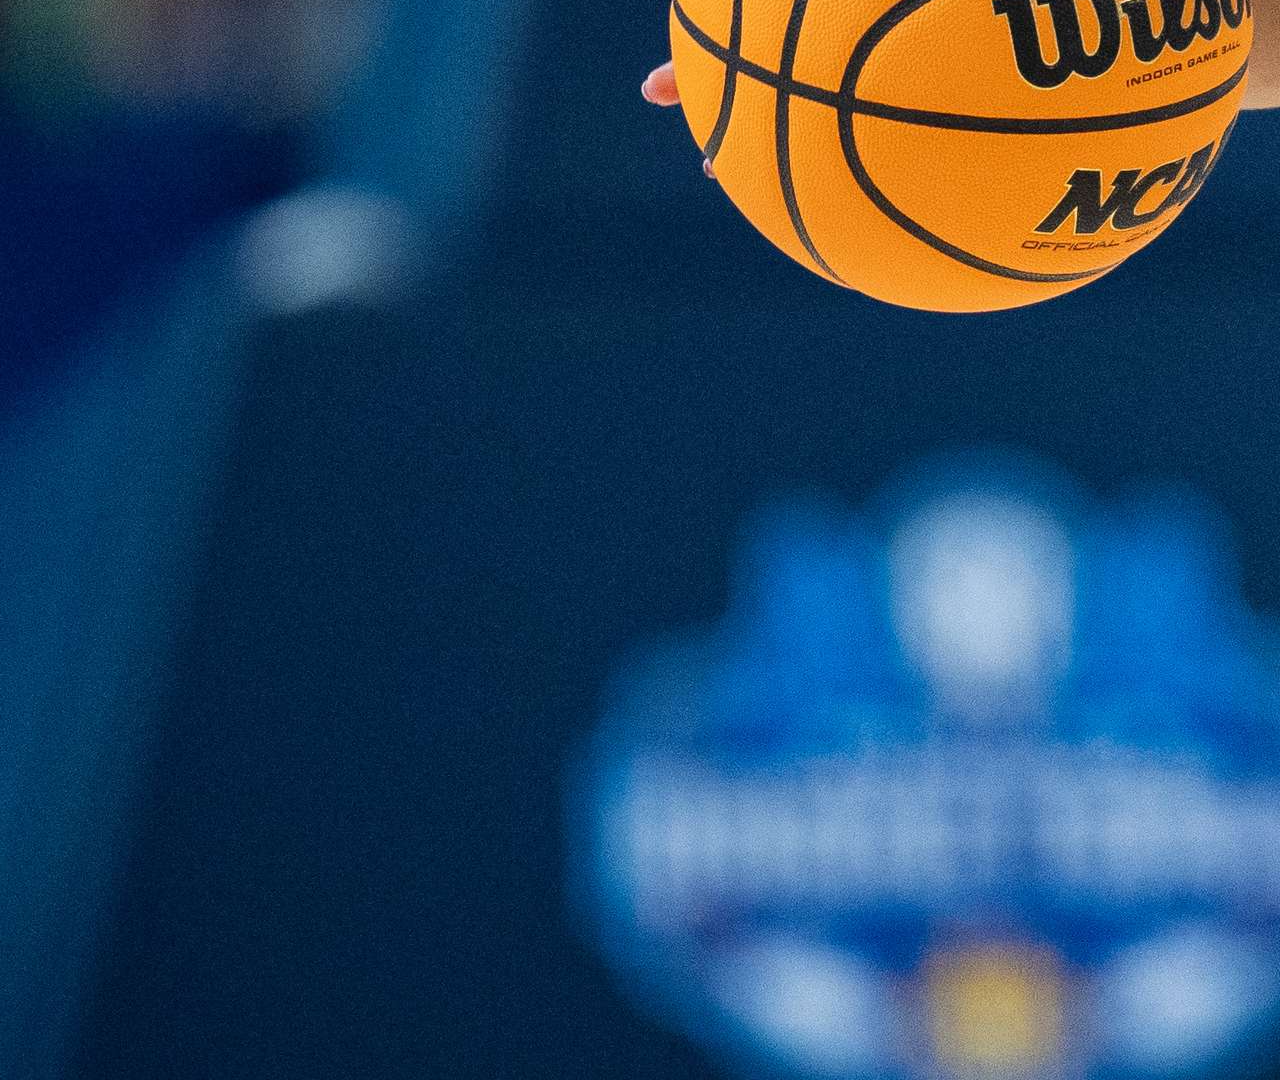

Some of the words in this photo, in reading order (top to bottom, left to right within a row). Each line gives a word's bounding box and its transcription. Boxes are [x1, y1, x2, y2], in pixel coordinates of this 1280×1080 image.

[1126, 62, 1183, 88] INDOOR
[1187, 48, 1219, 69] GAME
[1221, 39, 1241, 56] BALL
[1020, 239, 1120, 251] OFFICIAL
